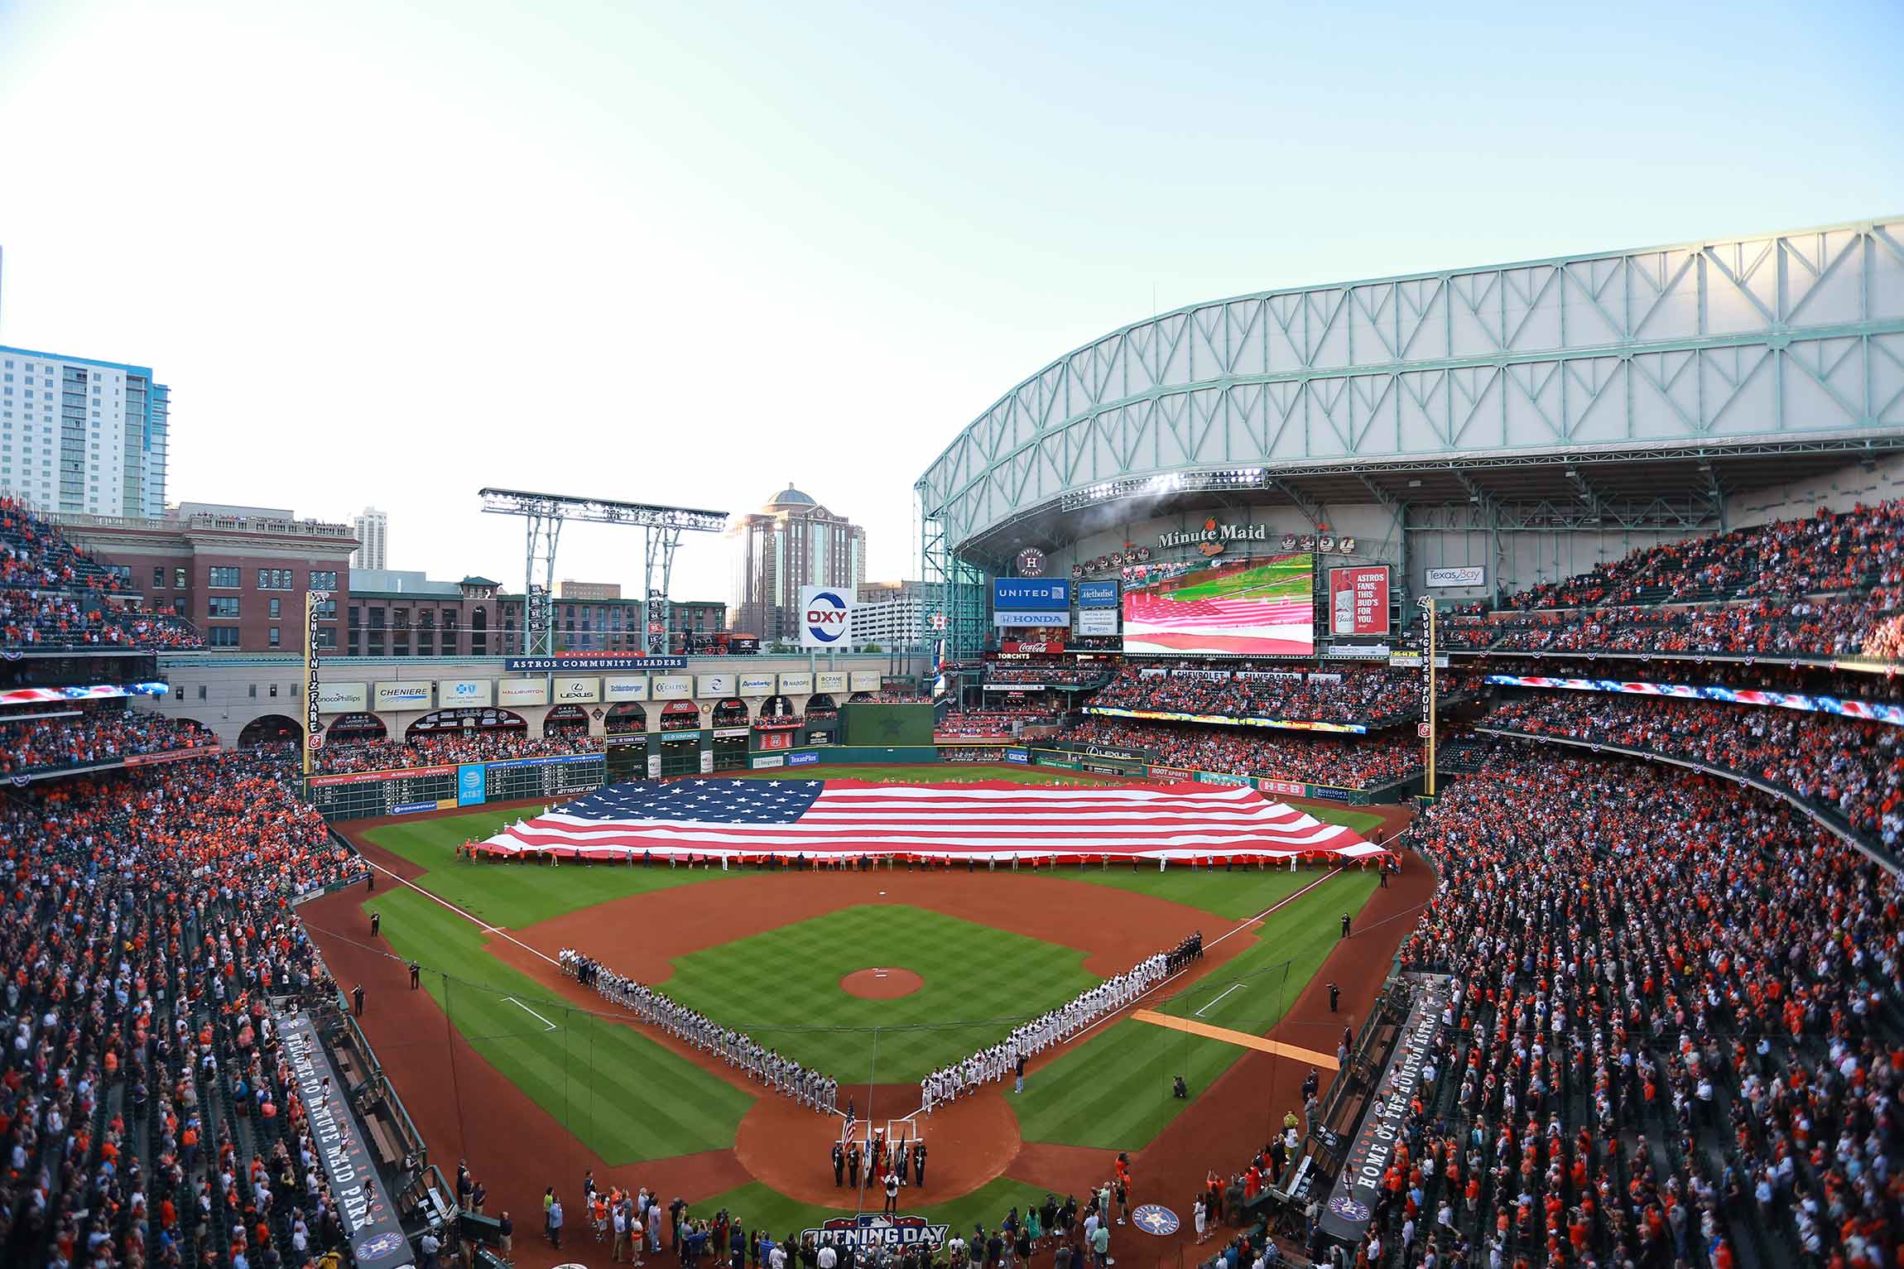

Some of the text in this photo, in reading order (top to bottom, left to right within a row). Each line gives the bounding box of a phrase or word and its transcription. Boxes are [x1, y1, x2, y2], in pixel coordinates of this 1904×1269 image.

[1159, 524, 1266, 548] Minute Maid
[1026, 557, 1038, 567] H
[1357, 574, 1385, 582] ASTROS
[1430, 569, 1480, 581] Texas Bay
[1000, 589, 1049, 597] UNITED
[1357, 599, 1379, 607] BUD'S
[807, 610, 847, 624] OXY
[1357, 607, 1372, 615] FOR
[1013, 615, 1062, 623] HONDA
[1422, 612, 1430, 672] BURGERZ
[512, 660, 557, 668] ASTROS
[562, 659, 632, 668] COMMUNITY
[1176, 671, 1225, 680] CHEVROLET
[380, 688, 428, 696] CHENIERE
[1422, 686, 1430, 722] FOUL
[310, 692, 318, 733] FARE
[1099, 750, 1131, 759] LEXUS
[286, 1032, 315, 1079] WELCOME
[302, 1078, 322, 1094] TO
[308, 1095, 341, 1143] MINUTE
[1357, 1143, 1389, 1190] HOME
[1398, 1046, 1425, 1094] HOUSTON
[326, 1144, 355, 1183] MAID
[341, 1185, 367, 1231] PARK
[802, 1226, 946, 1245] OPENING DAY
